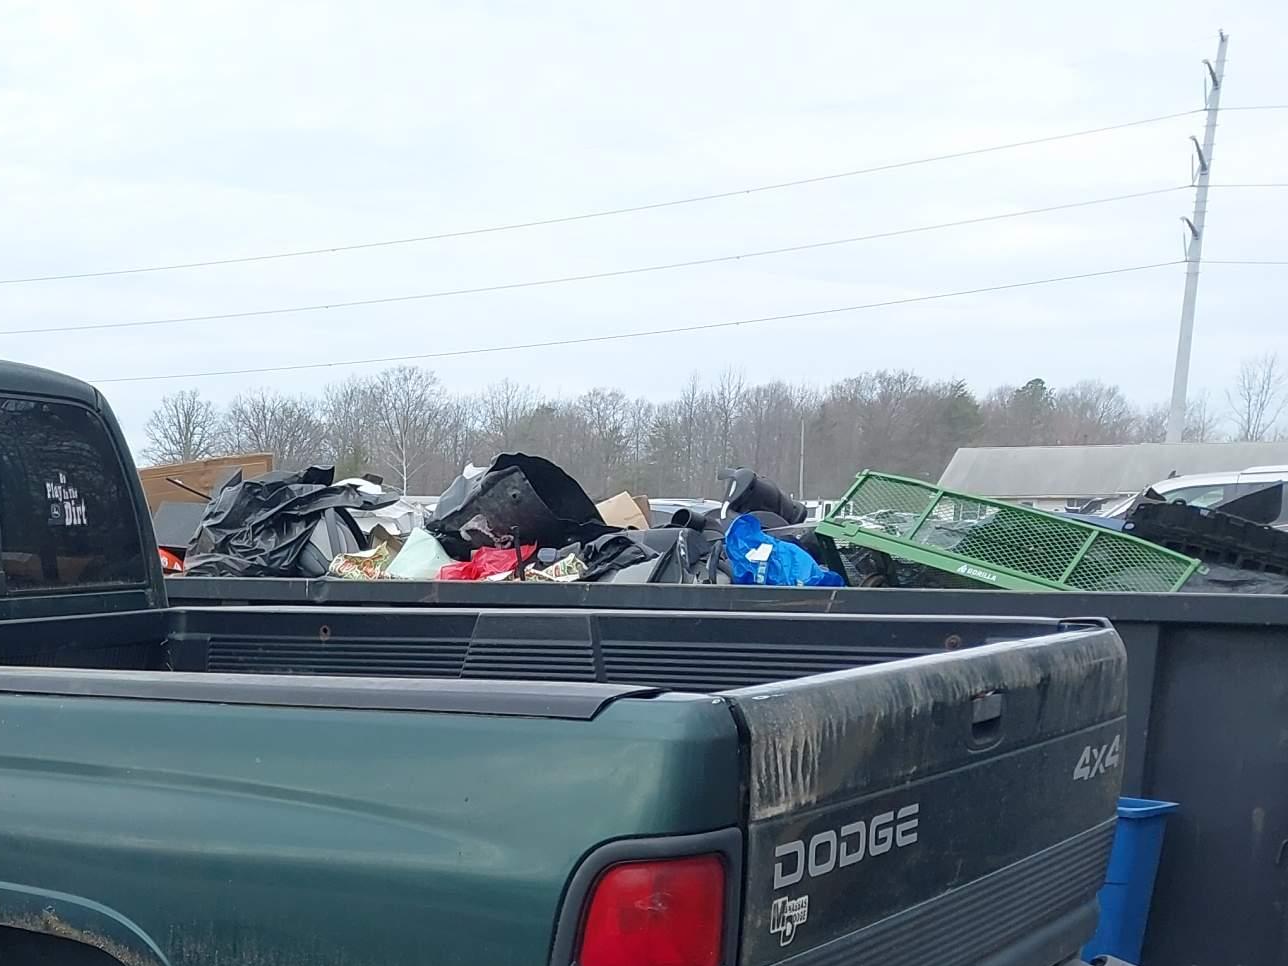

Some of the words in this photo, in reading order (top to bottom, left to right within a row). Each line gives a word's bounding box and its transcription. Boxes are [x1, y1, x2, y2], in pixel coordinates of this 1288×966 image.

[46, 482, 62, 502] Play
[63, 498, 87, 526] Dirt
[773, 803, 920, 890] DODGE
